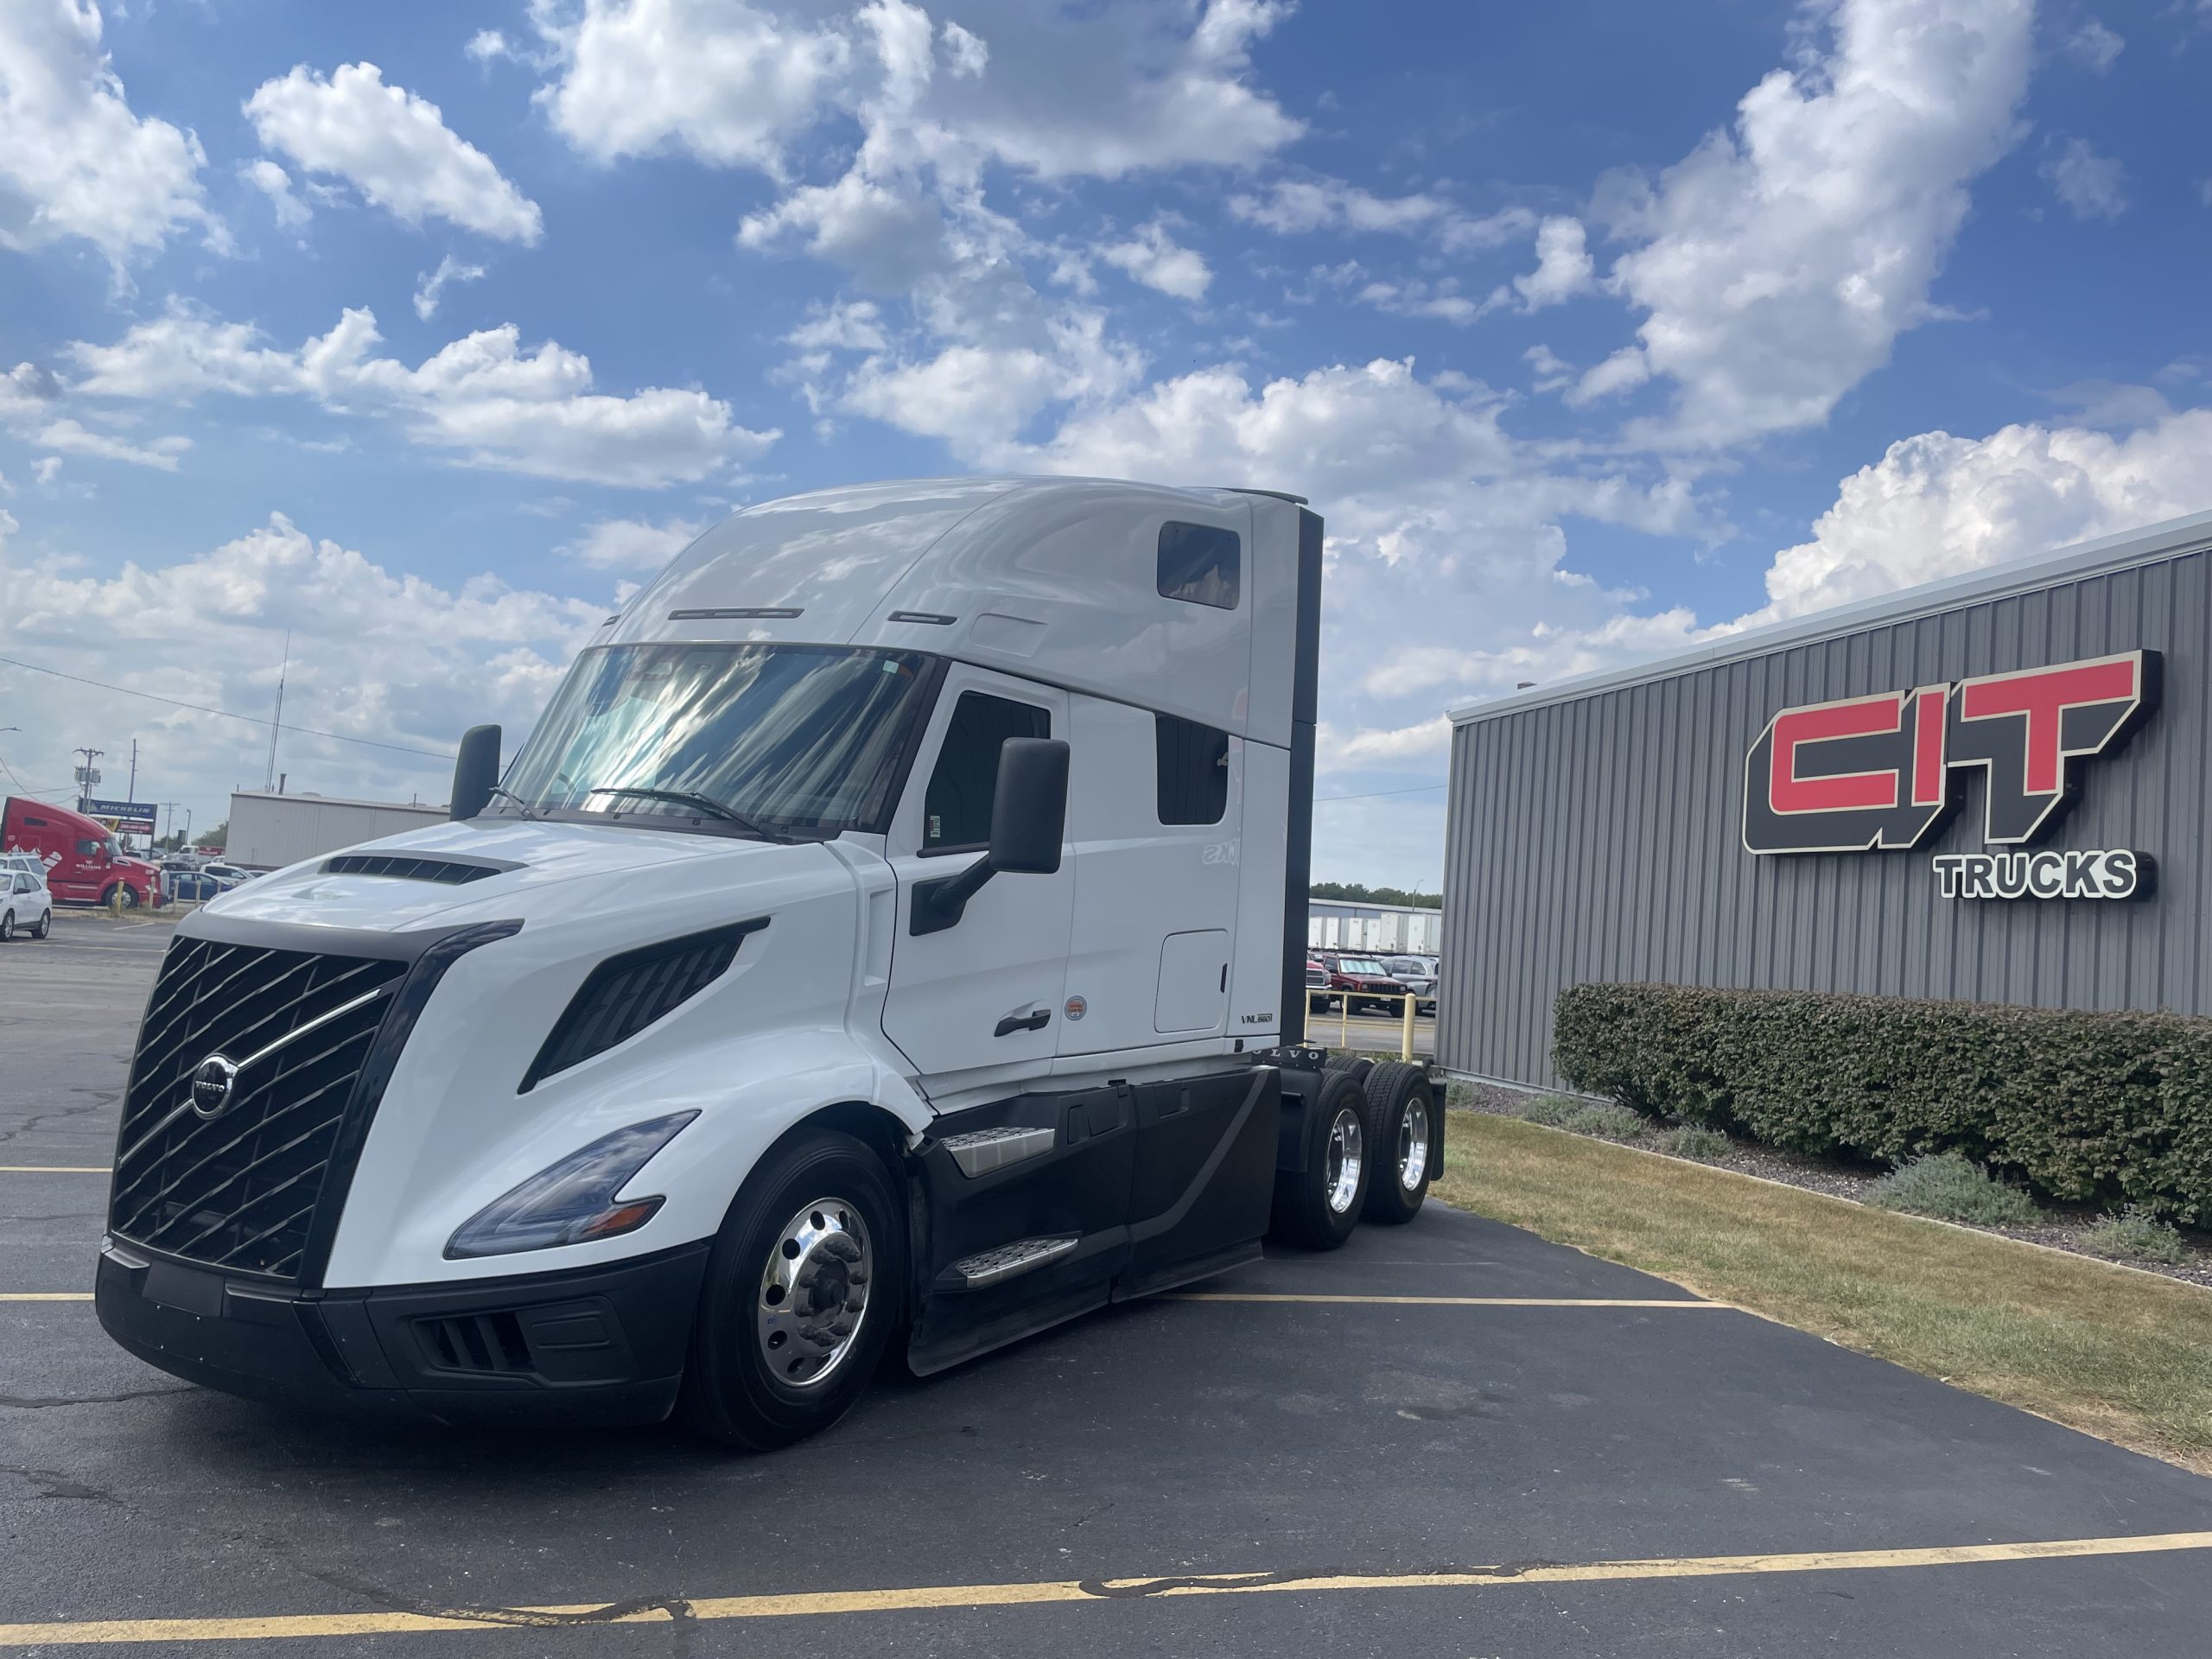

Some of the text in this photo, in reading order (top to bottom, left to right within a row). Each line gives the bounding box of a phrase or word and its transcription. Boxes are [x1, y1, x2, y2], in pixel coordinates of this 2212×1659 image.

[1768, 654, 2143, 817] CIT
[100, 804, 150, 814] MICHELIN
[1932, 849, 2137, 899] TRUCKS
[195, 1080, 226, 1092] VOLVO
